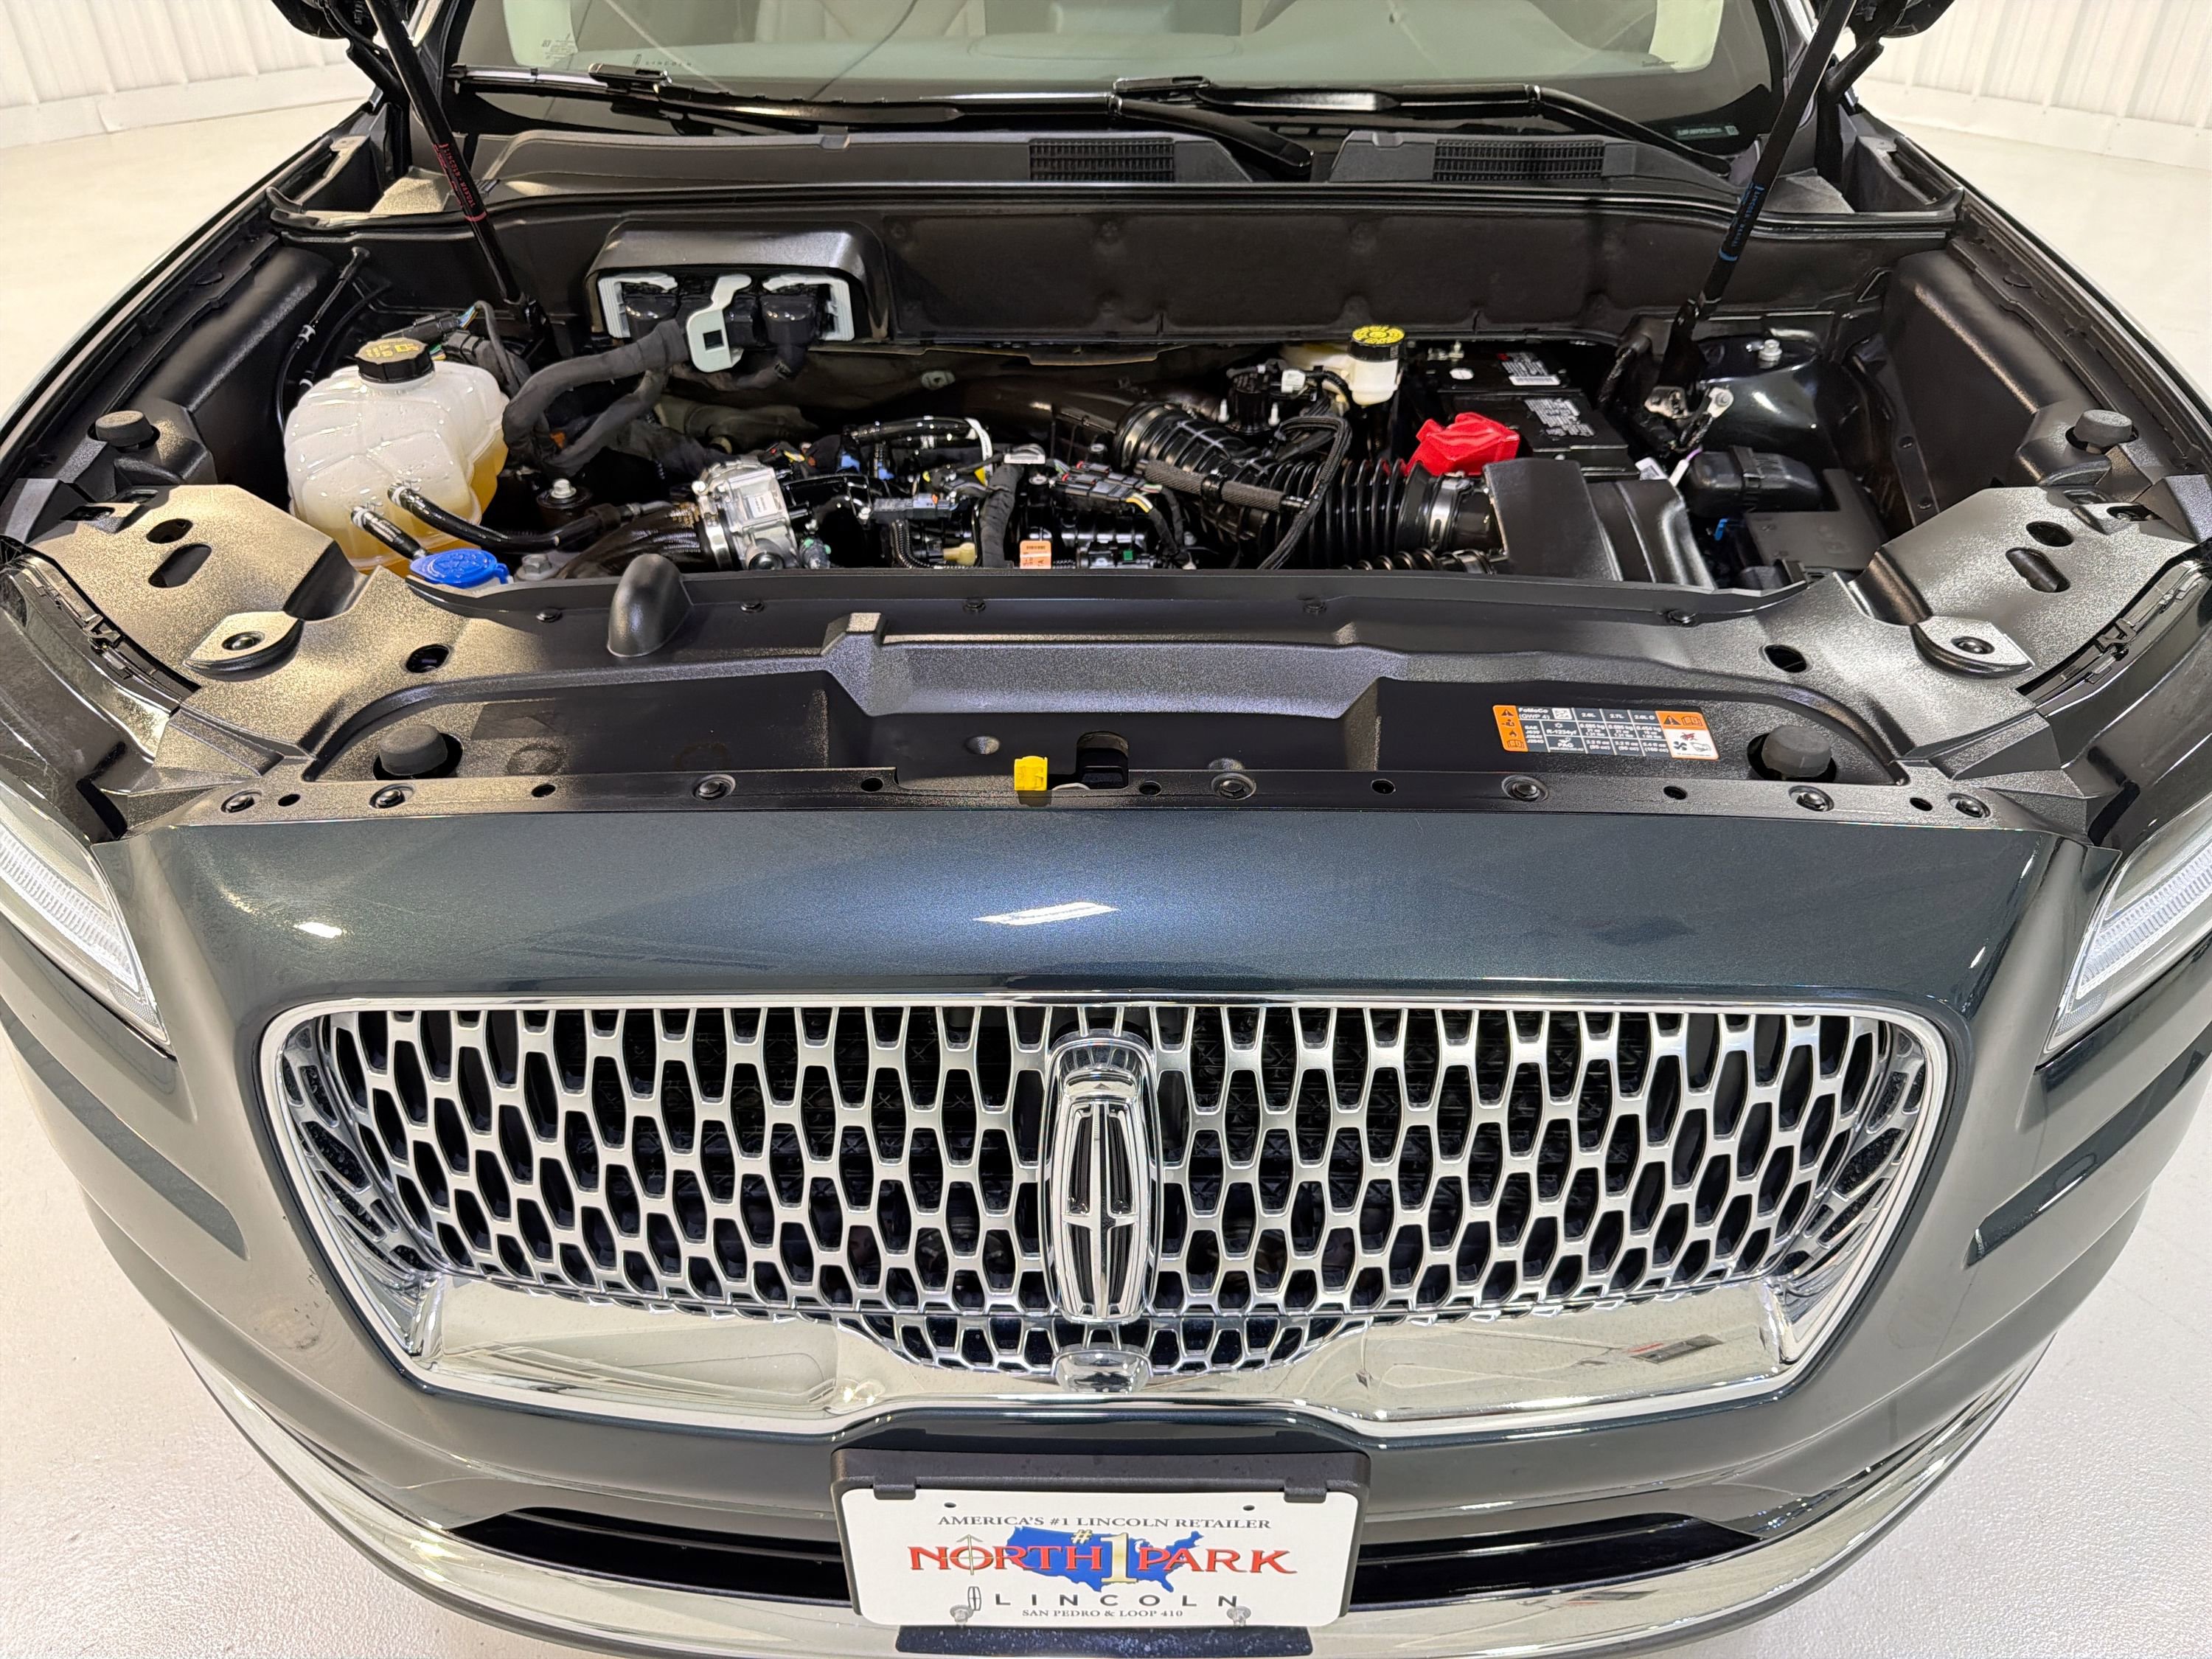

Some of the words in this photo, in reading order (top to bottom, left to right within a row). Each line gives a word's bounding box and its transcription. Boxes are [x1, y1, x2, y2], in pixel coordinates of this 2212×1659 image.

[937, 1515, 1045, 1526] AMERICA'S
[1049, 1517, 1070, 1526] #1
[1076, 1517, 1169, 1528] LINCOLN
[1174, 1518, 1271, 1529] RETAILER
[907, 1545, 1104, 1571] NORTH
[1137, 1546, 1298, 1574] PARK
[995, 1593, 1237, 1607] LINCOLN
[1022, 1609, 1048, 1617] SAN
